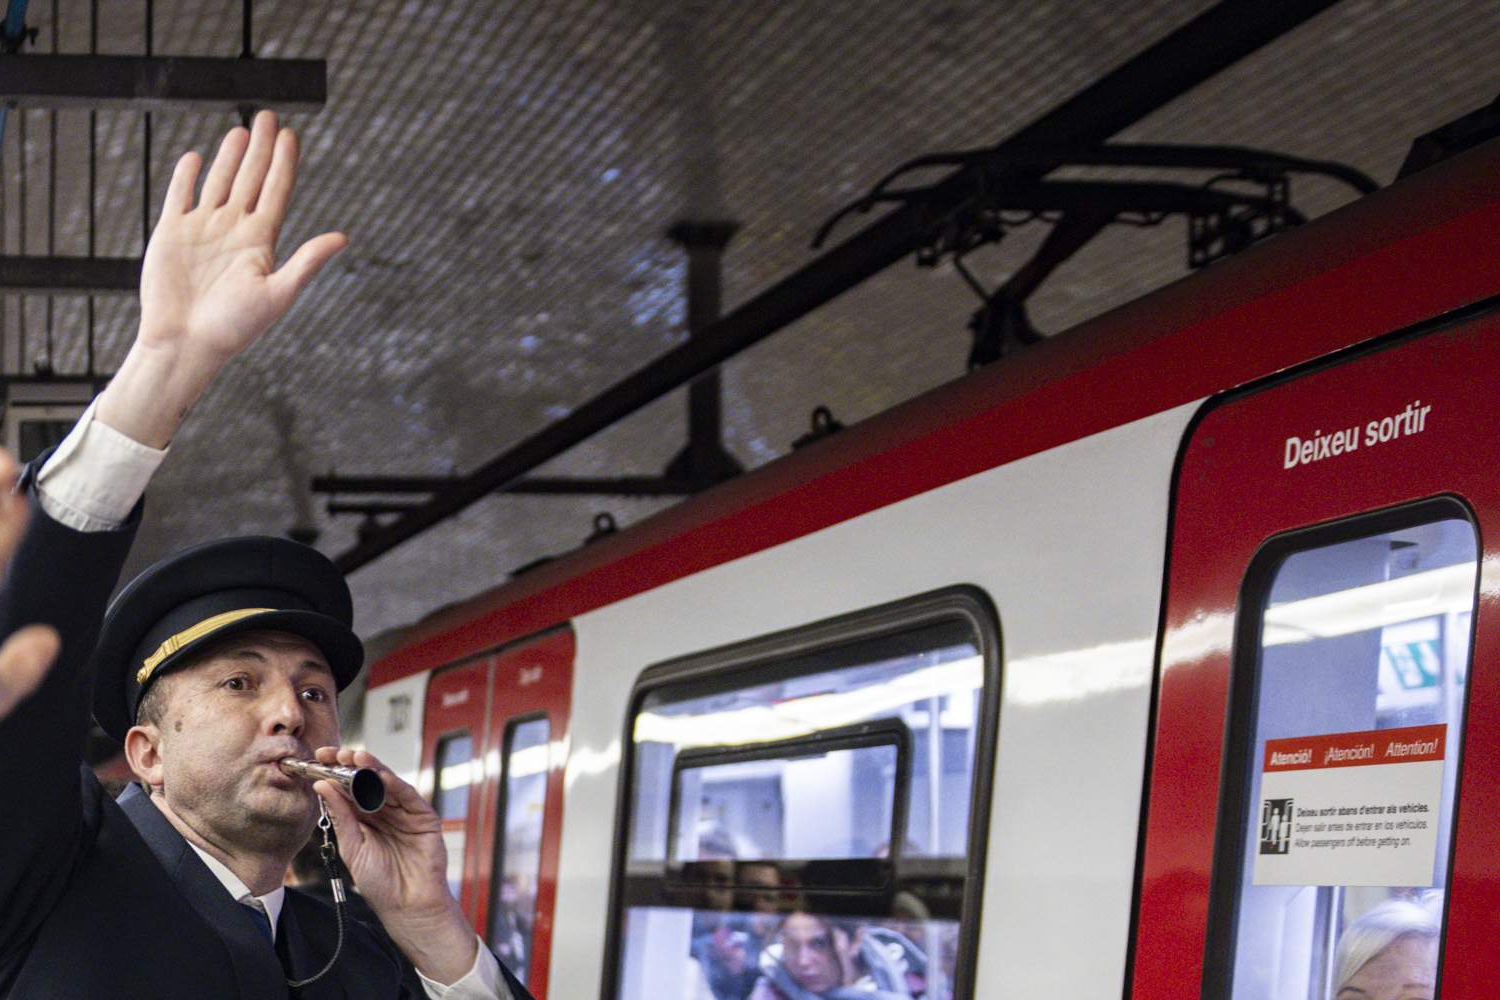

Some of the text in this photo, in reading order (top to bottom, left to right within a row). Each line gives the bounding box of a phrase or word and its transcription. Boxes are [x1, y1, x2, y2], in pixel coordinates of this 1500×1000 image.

[1283, 400, 1432, 470] Deixeu sortir
[1270, 738, 1439, 766] Atenció! ¡Atención! Attention!
